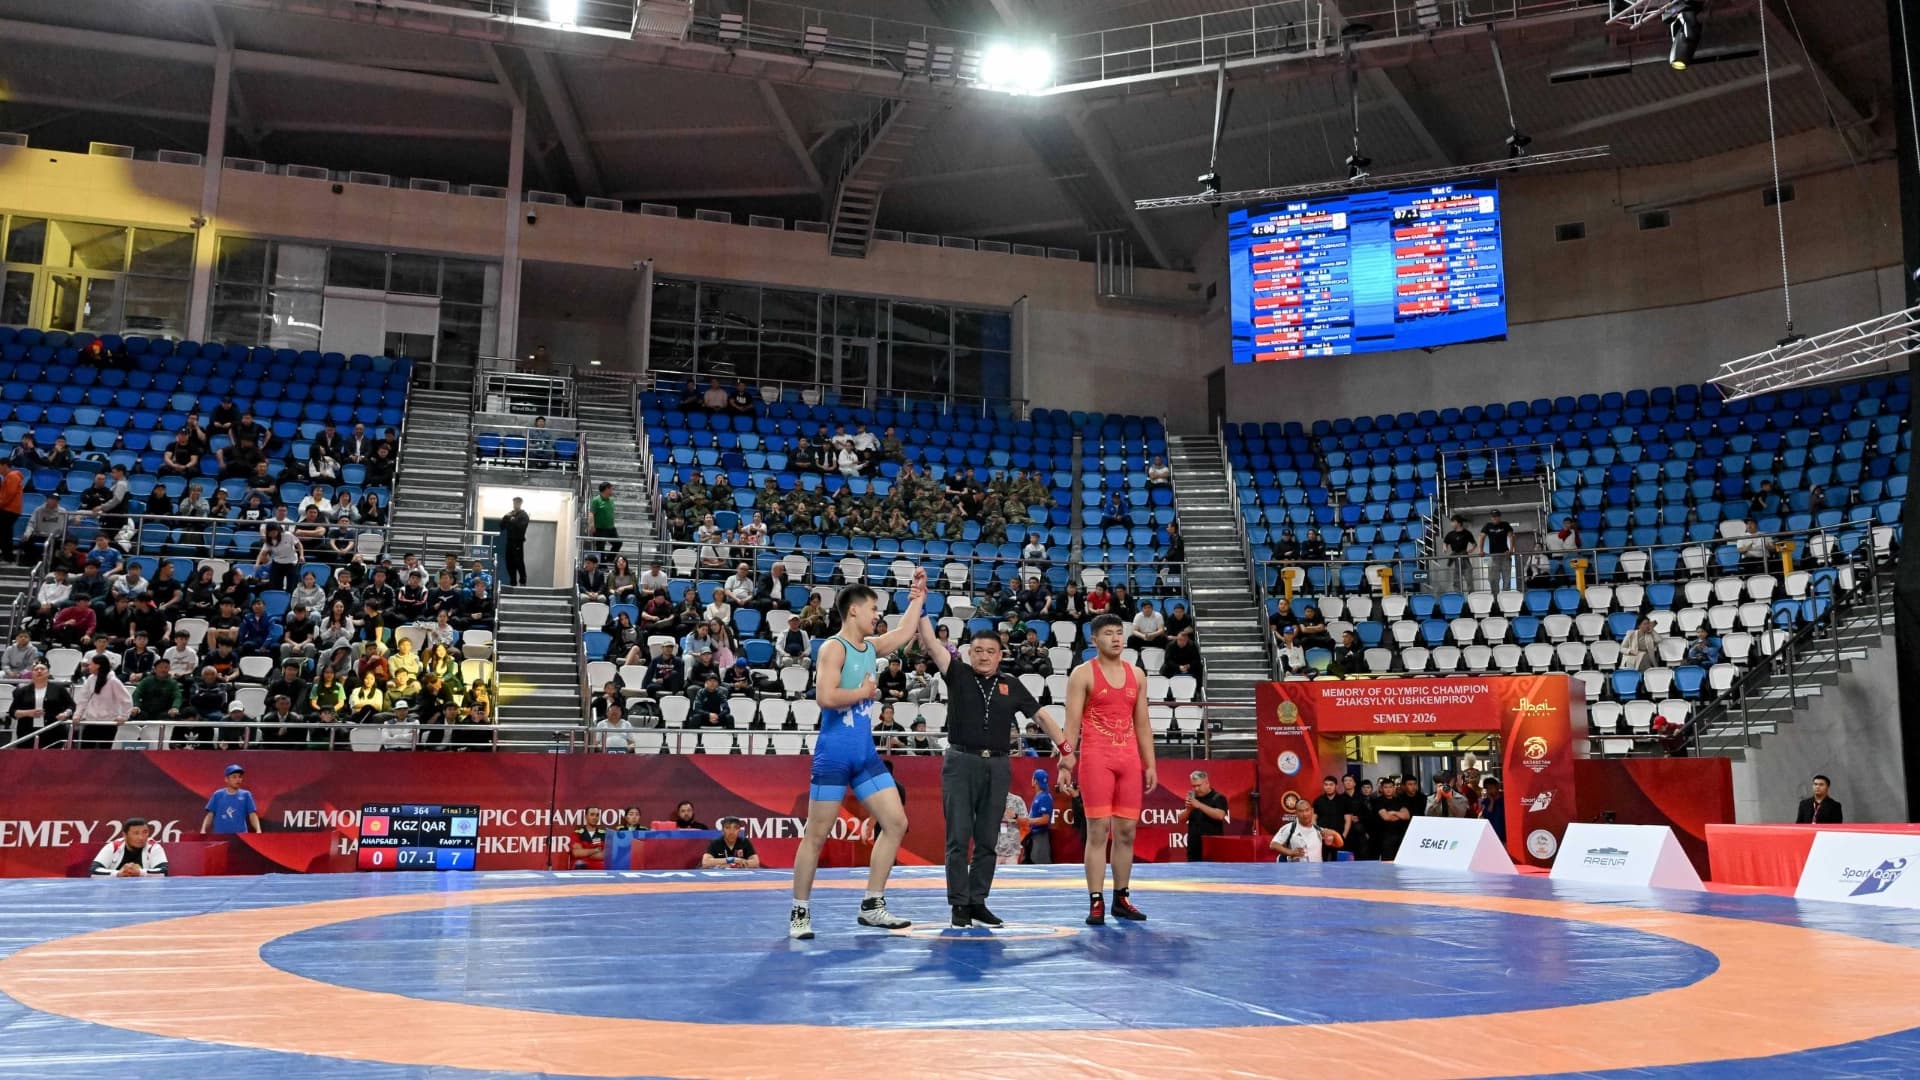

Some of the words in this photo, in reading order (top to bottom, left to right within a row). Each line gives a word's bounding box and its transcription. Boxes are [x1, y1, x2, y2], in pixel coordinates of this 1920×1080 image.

[1394, 209, 1418, 219] 07.1
[1252, 225, 1275, 234] 4:00
[1322, 688, 1364, 697] MEMORY
[1368, 688, 1381, 696] OF
[1384, 686, 1429, 696] OLYMPIC
[1432, 685, 1489, 694] CHAMPION
[1336, 697, 1396, 706] ZHAKSYLYK
[1398, 695, 1475, 705] USHKEMPIROV
[1373, 713, 1410, 724] SEMEY
[1412, 713, 1436, 723] 2026
[284, 810, 361, 828] MEMO
[105, 820, 182, 844] 226
[393, 821, 418, 831] KGZ
[421, 821, 446, 832] QAR
[1420, 838, 1448, 850] SEMEI
[372, 851, 383, 865] 0
[398, 851, 436, 864] 07.1
[451, 852, 462, 865] 7
[1842, 867, 1871, 879] Sport
